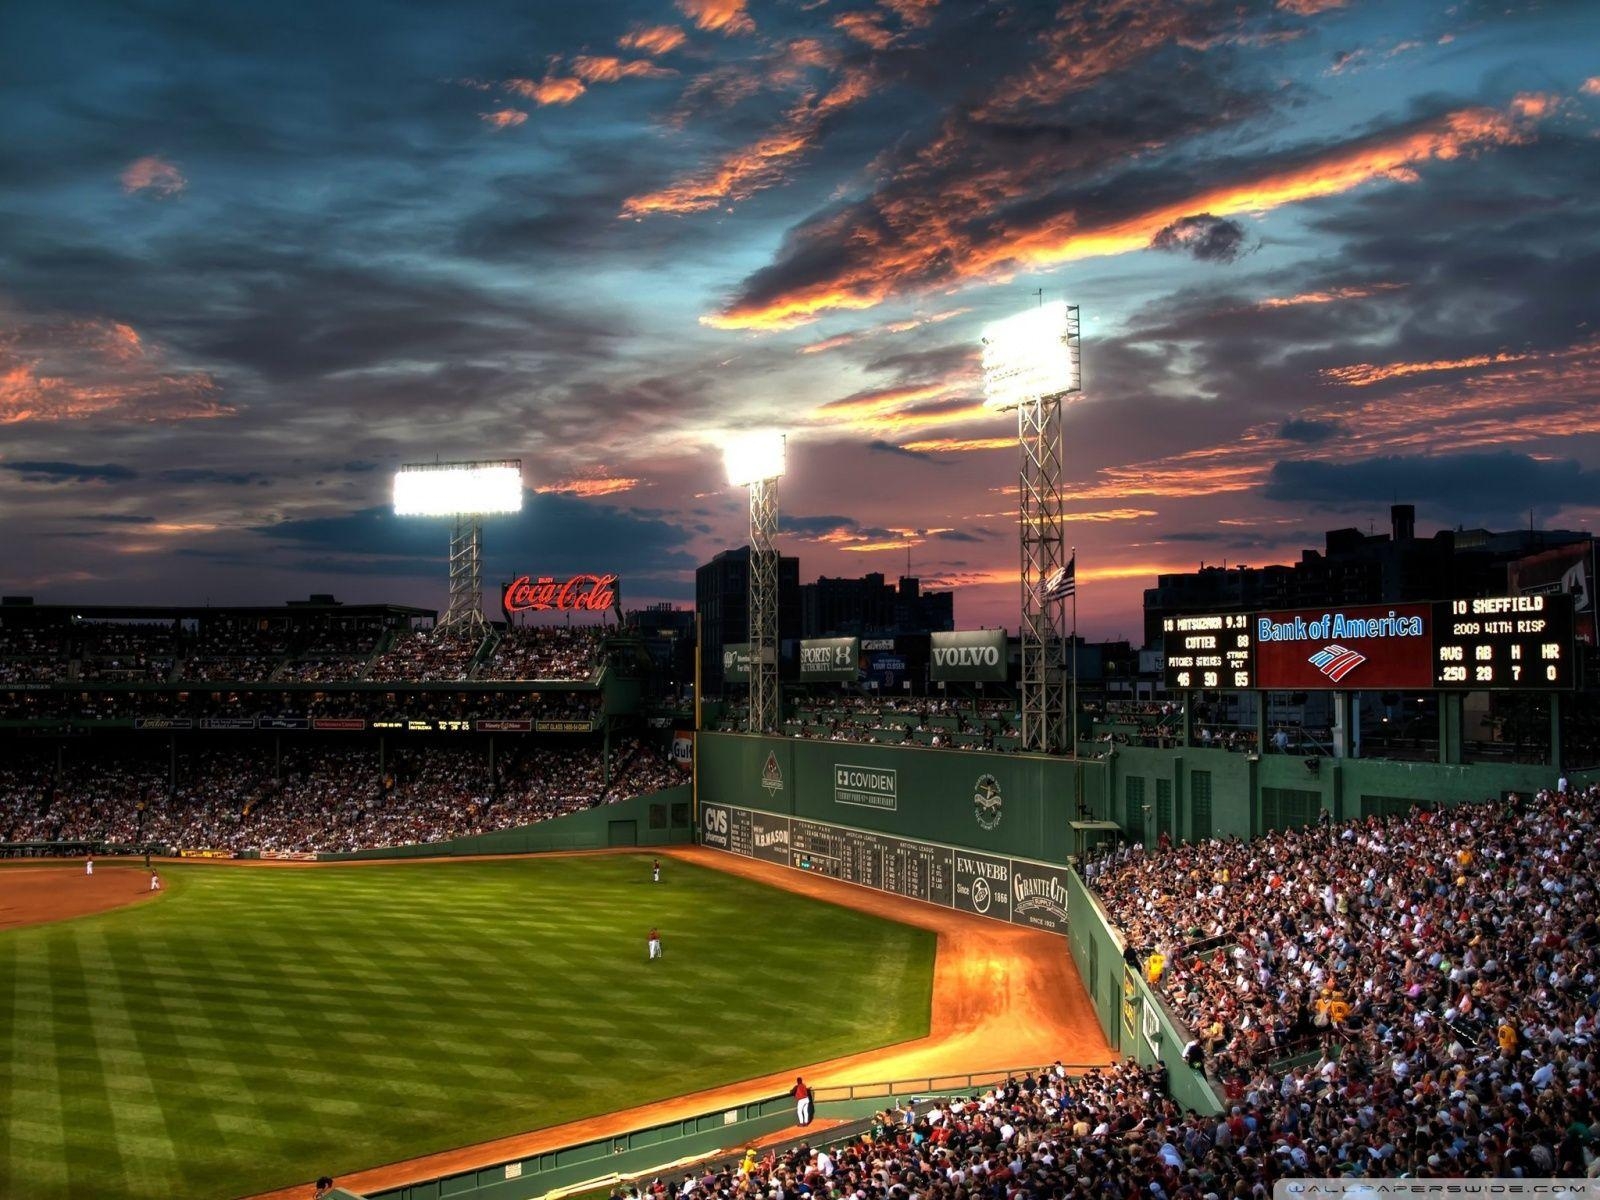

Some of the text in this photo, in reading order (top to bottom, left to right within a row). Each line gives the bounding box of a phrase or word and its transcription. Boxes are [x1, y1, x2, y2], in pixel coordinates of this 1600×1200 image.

[504, 574, 618, 612] Coca-Cola
[1453, 596, 1543, 615] 10 SHEFFIELD
[1177, 616, 1222, 631] MATSUZAKA
[1225, 615, 1246, 629] 9.31
[1258, 610, 1423, 641] Bank of America
[1453, 619, 1546, 635] 2009 WITH RISP
[1185, 636, 1216, 649] CUTTER
[801, 646, 831, 664] SPORTS
[932, 646, 999, 666] VOLVO
[1440, 643, 1560, 660] AVG AB H HR
[1168, 656, 1222, 667] PITCHES STRIKES
[1230, 660, 1244, 668] PCT
[1177, 671, 1249, 687] 46 30 65
[1438, 664, 1557, 681] .250 28 7 0
[850, 771, 894, 791] COVIDIEN
[705, 807, 728, 834] CVS
[705, 831, 727, 847] pharmacy
[976, 860, 1007, 881] WEBB
[956, 883, 970, 895] Since
